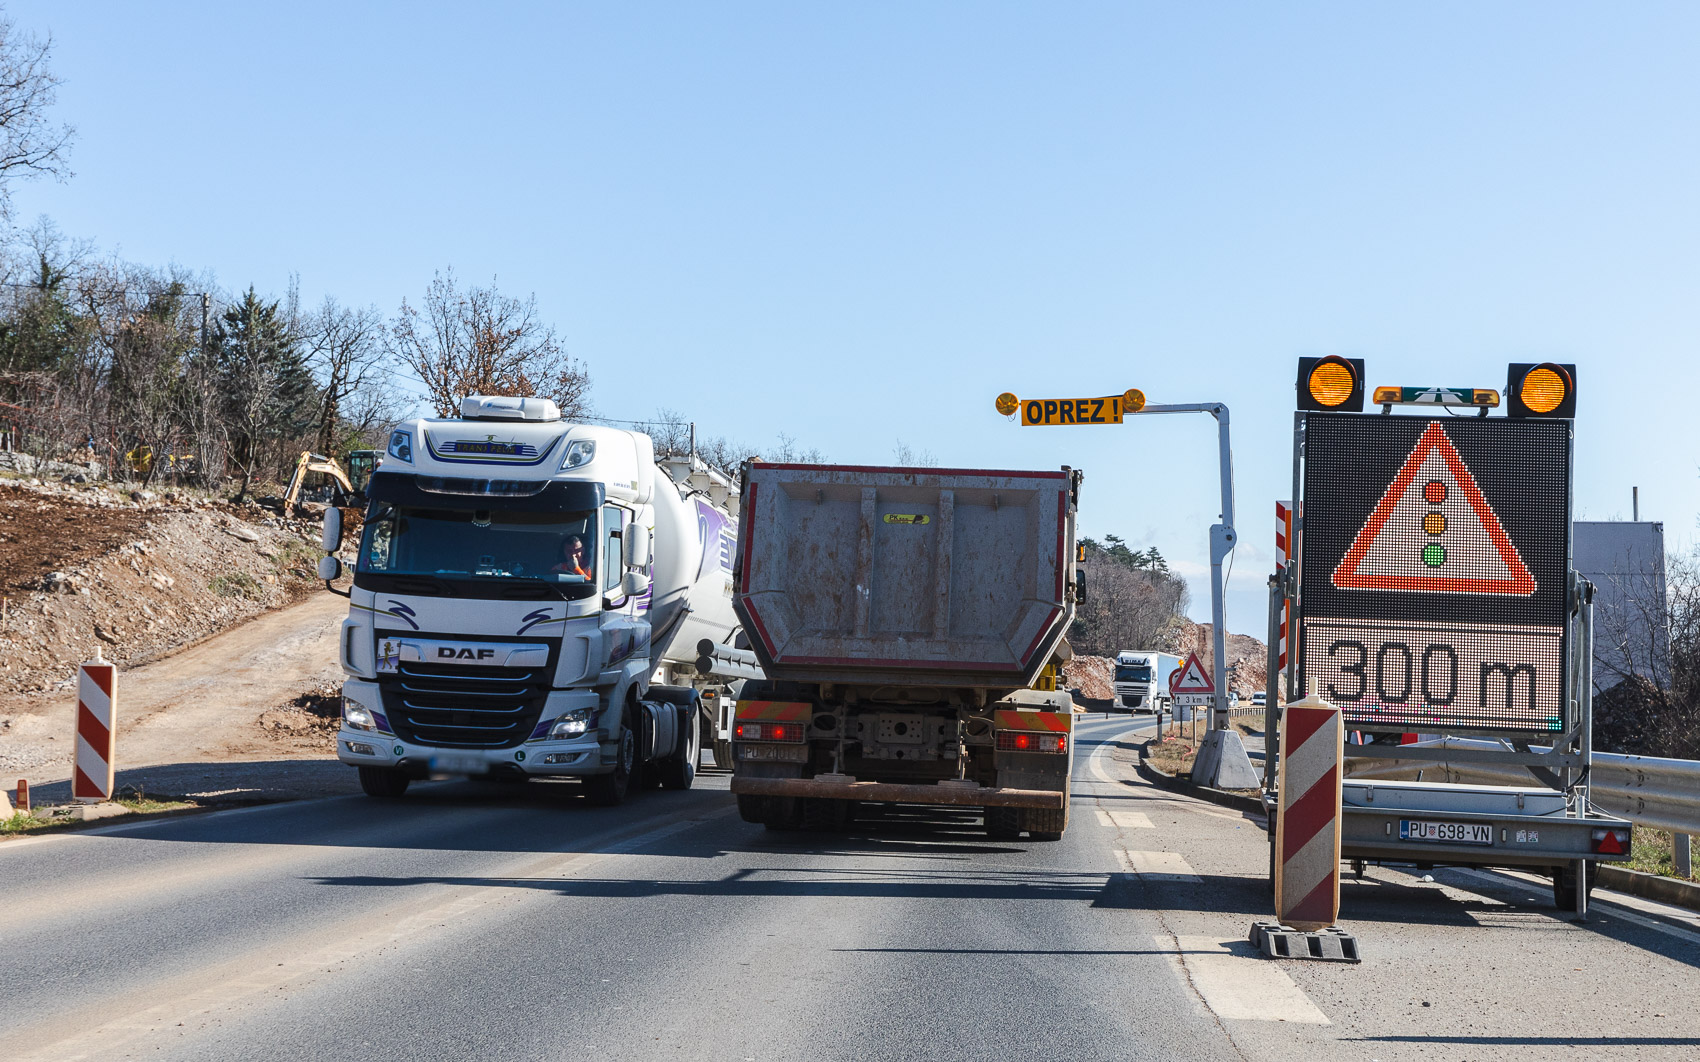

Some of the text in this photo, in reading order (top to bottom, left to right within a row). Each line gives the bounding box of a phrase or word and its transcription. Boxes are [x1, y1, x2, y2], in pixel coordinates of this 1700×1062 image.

[1026, 400, 1105, 424] OPREZ
[437, 646, 495, 660] DAF
[1327, 639, 1537, 709] 300 m
[745, 746, 759, 758] PU
[1410, 822, 1490, 841] PU 698-VN
